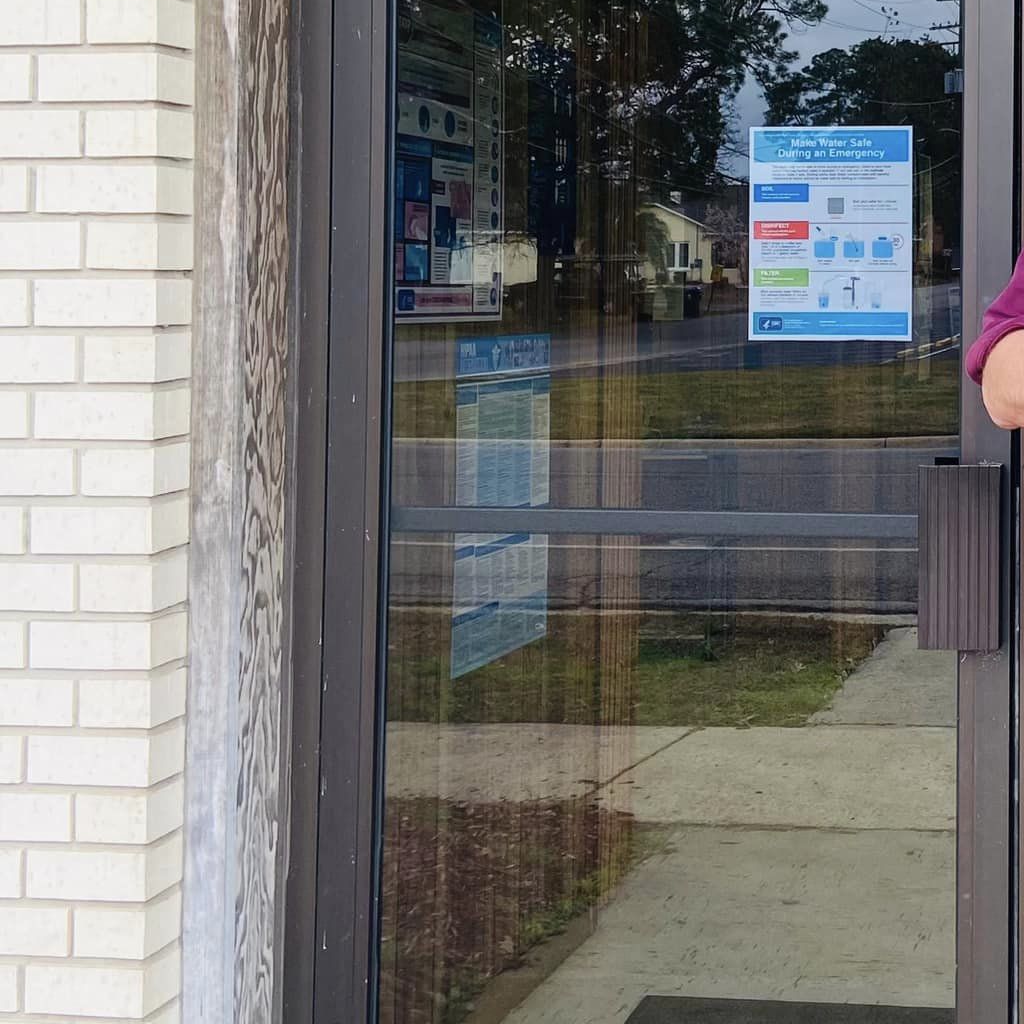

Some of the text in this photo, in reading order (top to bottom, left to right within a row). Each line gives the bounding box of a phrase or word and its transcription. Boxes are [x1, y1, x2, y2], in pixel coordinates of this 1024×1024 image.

[791, 138, 872, 148] Make Water Safe
[778, 148, 885, 160] During an Emergency
